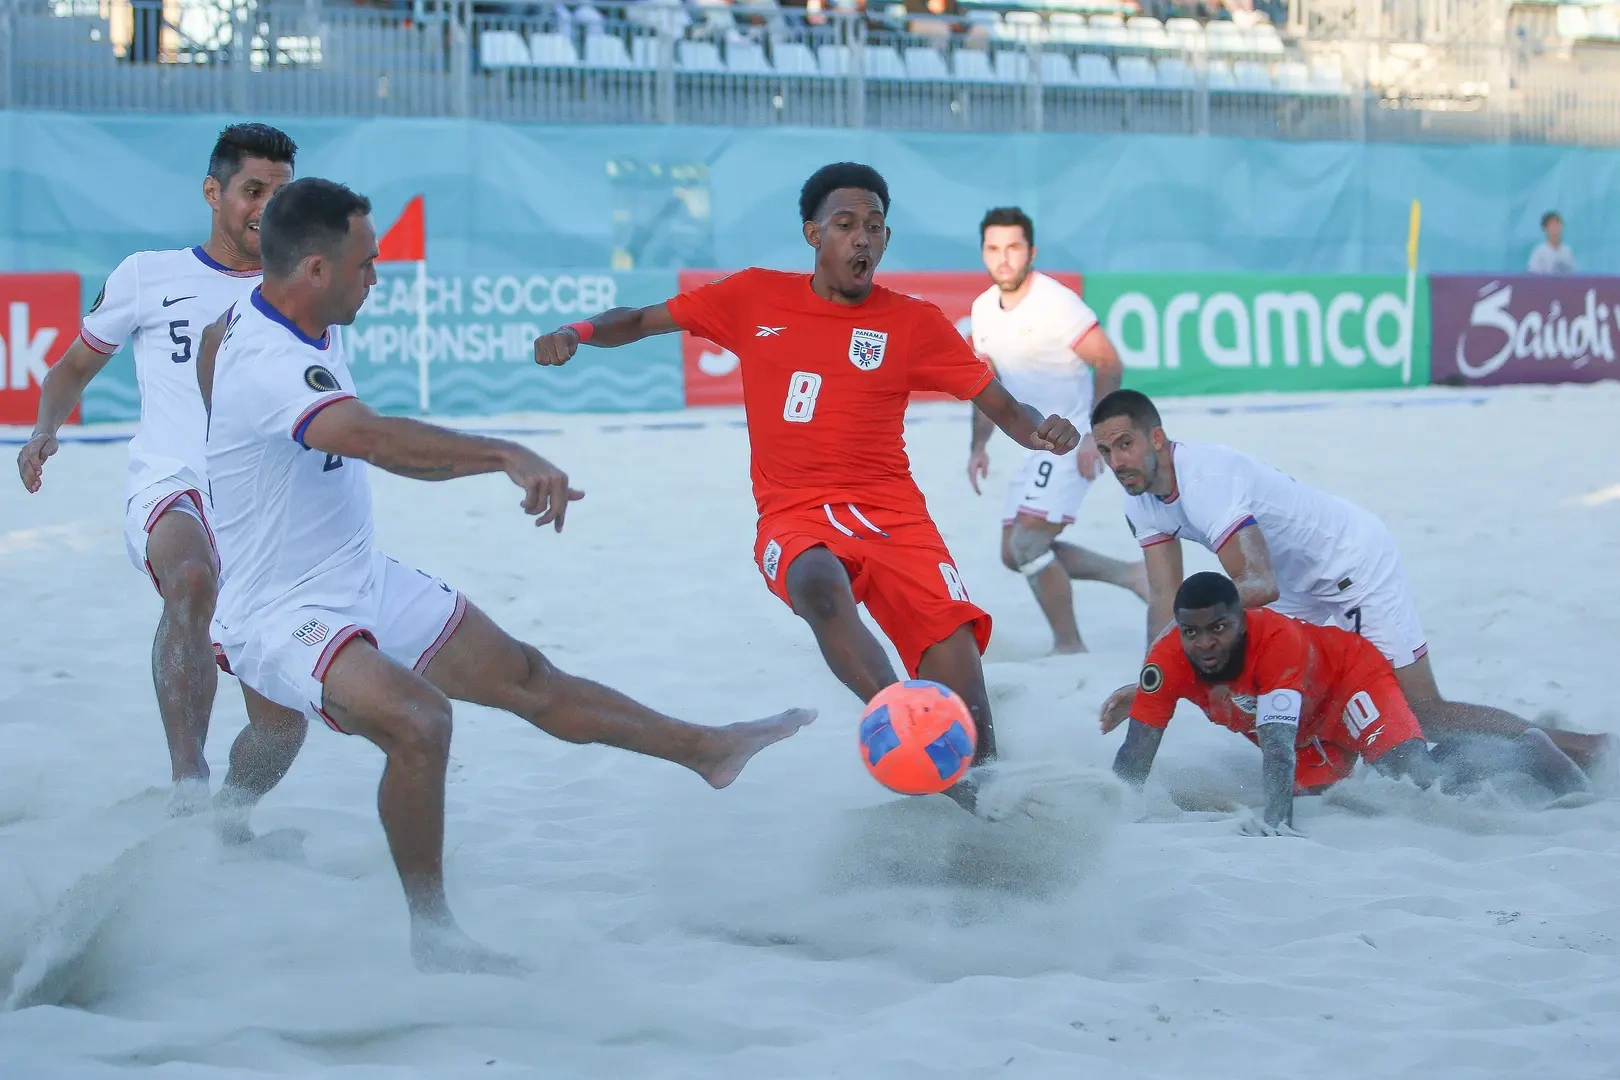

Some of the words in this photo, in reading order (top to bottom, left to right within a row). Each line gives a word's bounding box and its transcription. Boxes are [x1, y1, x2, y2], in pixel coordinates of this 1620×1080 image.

[359, 276, 463, 315] EACH
[471, 275, 617, 315] SOCCER
[169, 319, 191, 363] 5
[346, 324, 541, 363] MPIONSHIP
[855, 330, 884, 340] PANAMA
[1106, 291, 1407, 368] aramco
[1456, 280, 1615, 378] Saudi
[783, 370, 823, 423] 8
[1034, 460, 1053, 488] 9
[295, 620, 319, 638] USA
[1344, 606, 1361, 634] 7
[1342, 690, 1380, 740] 10
